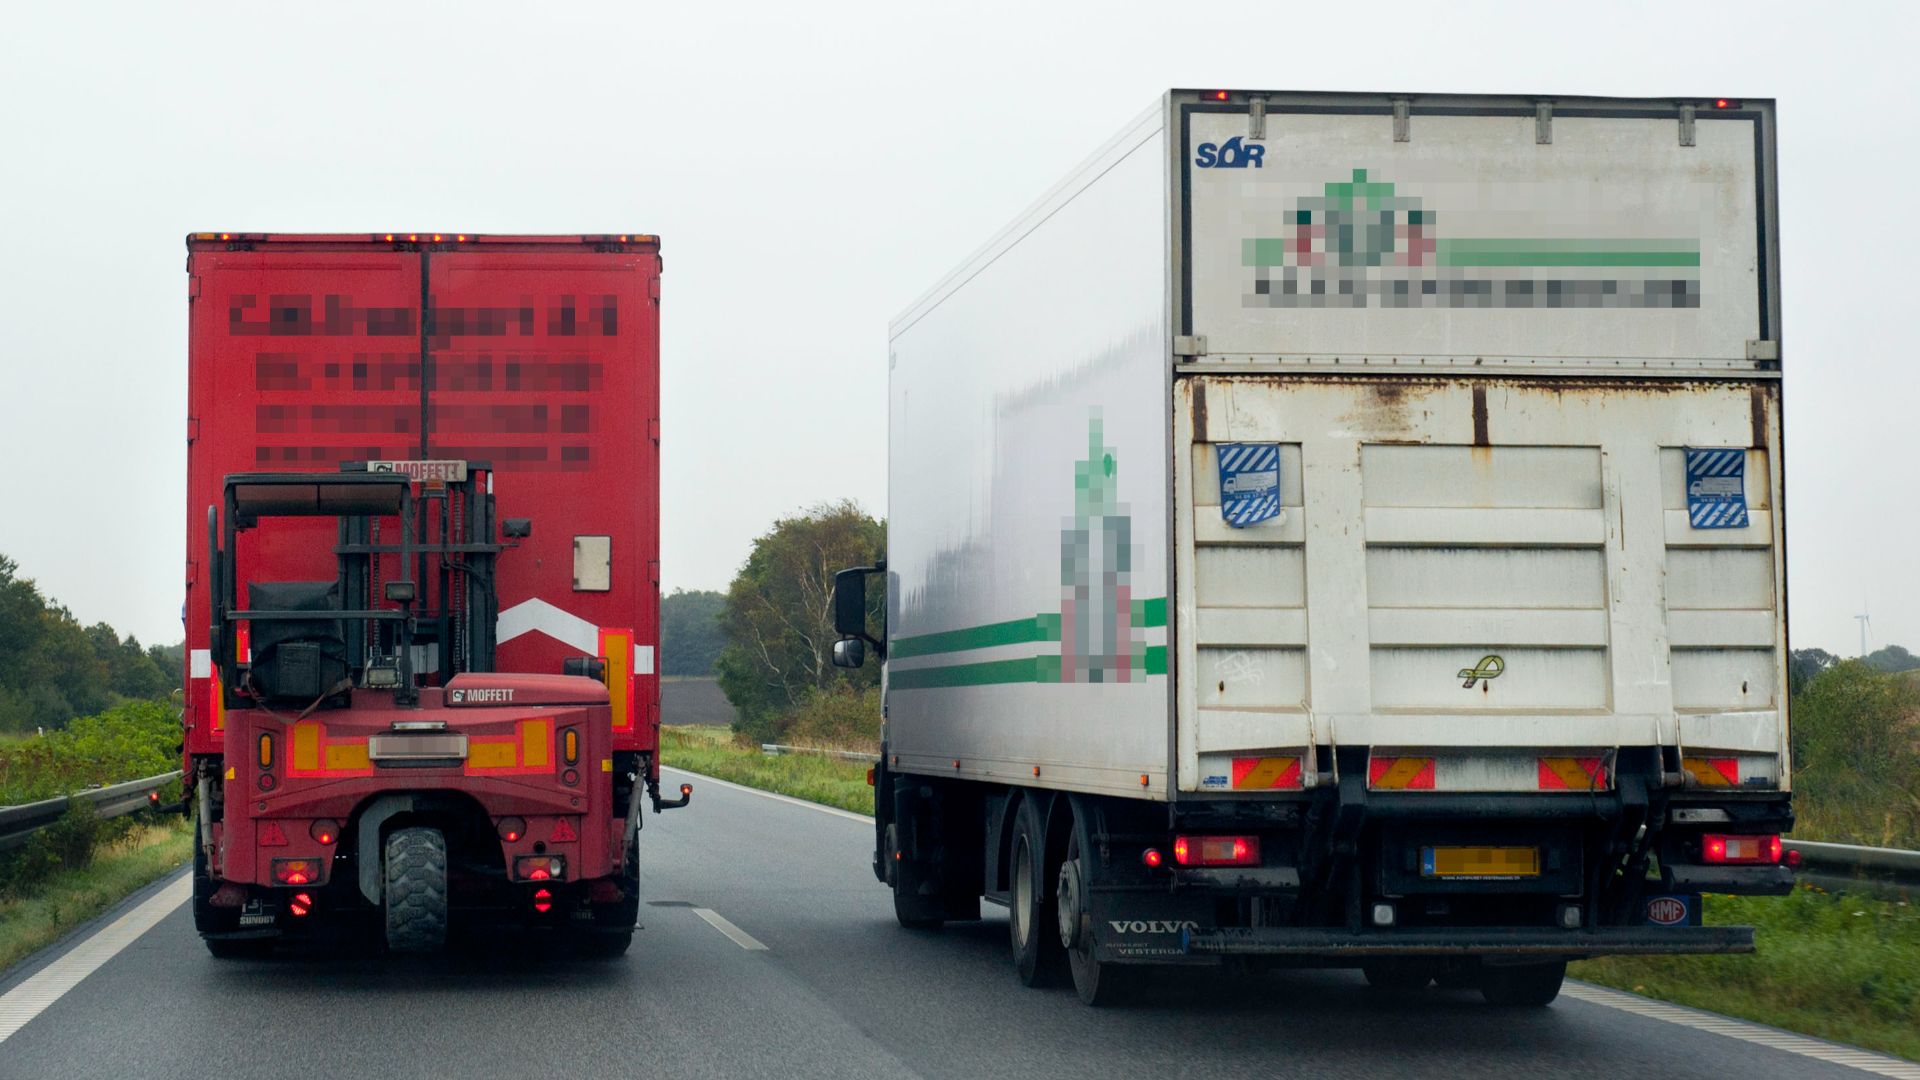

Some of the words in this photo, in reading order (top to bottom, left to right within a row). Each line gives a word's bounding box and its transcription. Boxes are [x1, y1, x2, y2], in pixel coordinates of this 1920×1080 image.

[396, 463, 460, 480] MOFFETT
[467, 688, 514, 702] MOFFETT
[1651, 901, 1681, 921] HMF
